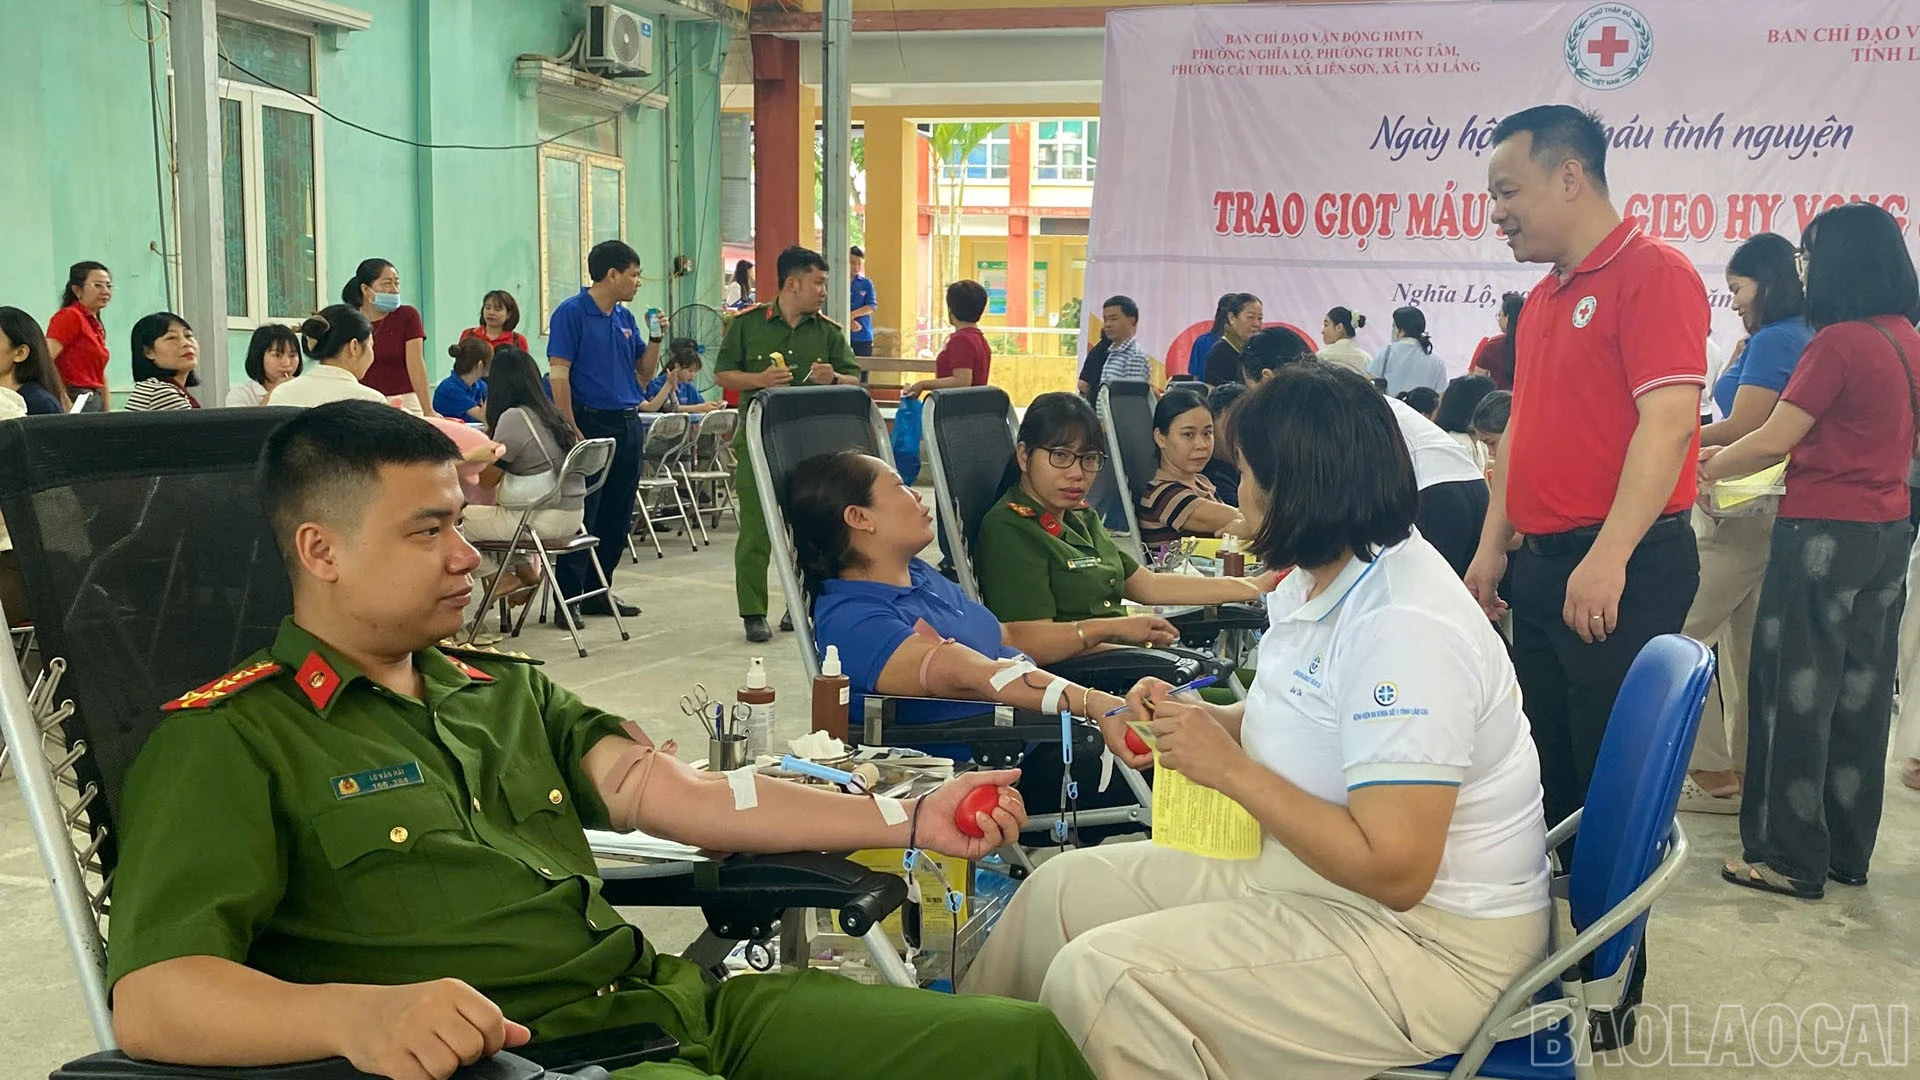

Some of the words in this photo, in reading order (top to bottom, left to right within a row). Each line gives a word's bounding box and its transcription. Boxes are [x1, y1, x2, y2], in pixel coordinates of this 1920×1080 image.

[1226, 33, 1251, 45] BAN
[1384, 30, 1424, 42] HMTN
[1767, 28, 1808, 43] BAN
[1856, 25, 1901, 45] ĐẠO
[1249, 46, 1289, 60] NGHĨA
[1376, 46, 1423, 58] TRUNG
[1425, 62, 1439, 73] XI
[1369, 114, 1450, 162] Ngày
[1458, 114, 1498, 157] hộ
[1663, 112, 1725, 151] tình
[1732, 114, 1855, 161] nguyện
[1213, 190, 1306, 237] TRAO
[1313, 192, 1400, 251] GIỌT
[1404, 180, 1491, 240] MÁU
[1622, 192, 1717, 241] GIEO
[1724, 192, 1785, 241] HY
[1391, 283, 1457, 307] Nghĩa
[1461, 284, 1497, 309] Lộ,
